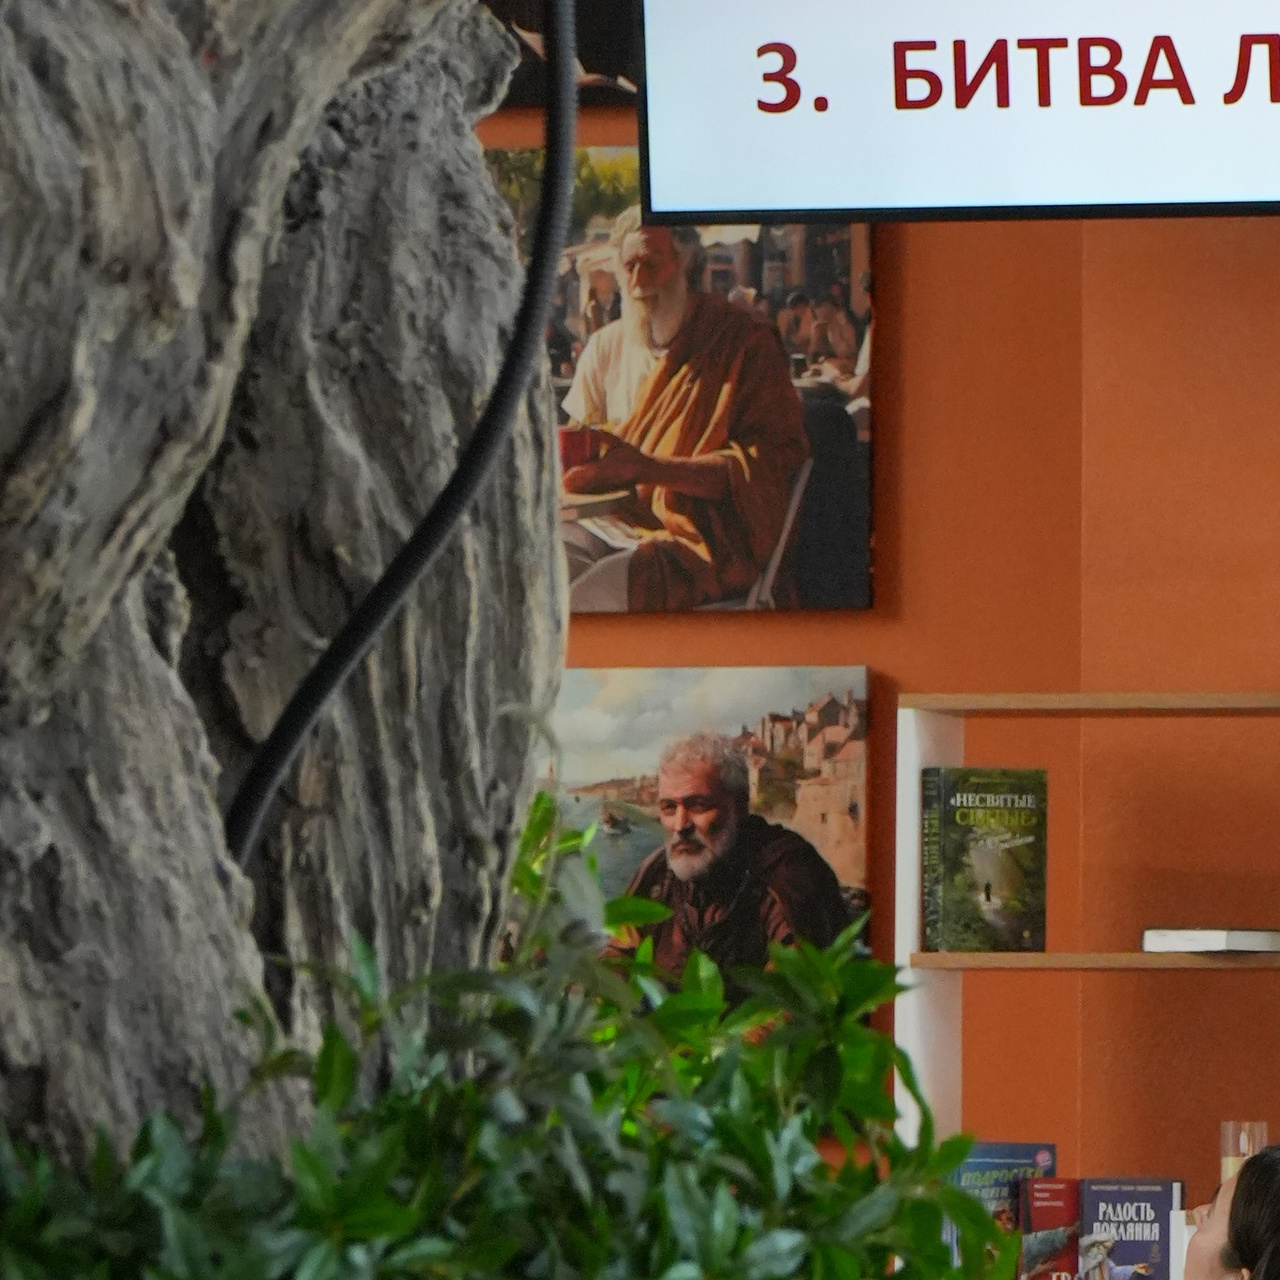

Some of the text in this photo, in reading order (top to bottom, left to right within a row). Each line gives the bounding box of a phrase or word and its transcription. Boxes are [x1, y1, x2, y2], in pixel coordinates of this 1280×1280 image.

[757, 43, 828, 113] 3.
[892, 35, 1194, 109] БИТВА
[1098, 1202, 1156, 1221] РАДОСТЬ
[1092, 1222, 1160, 1242] ПОКАЯНИЯ
